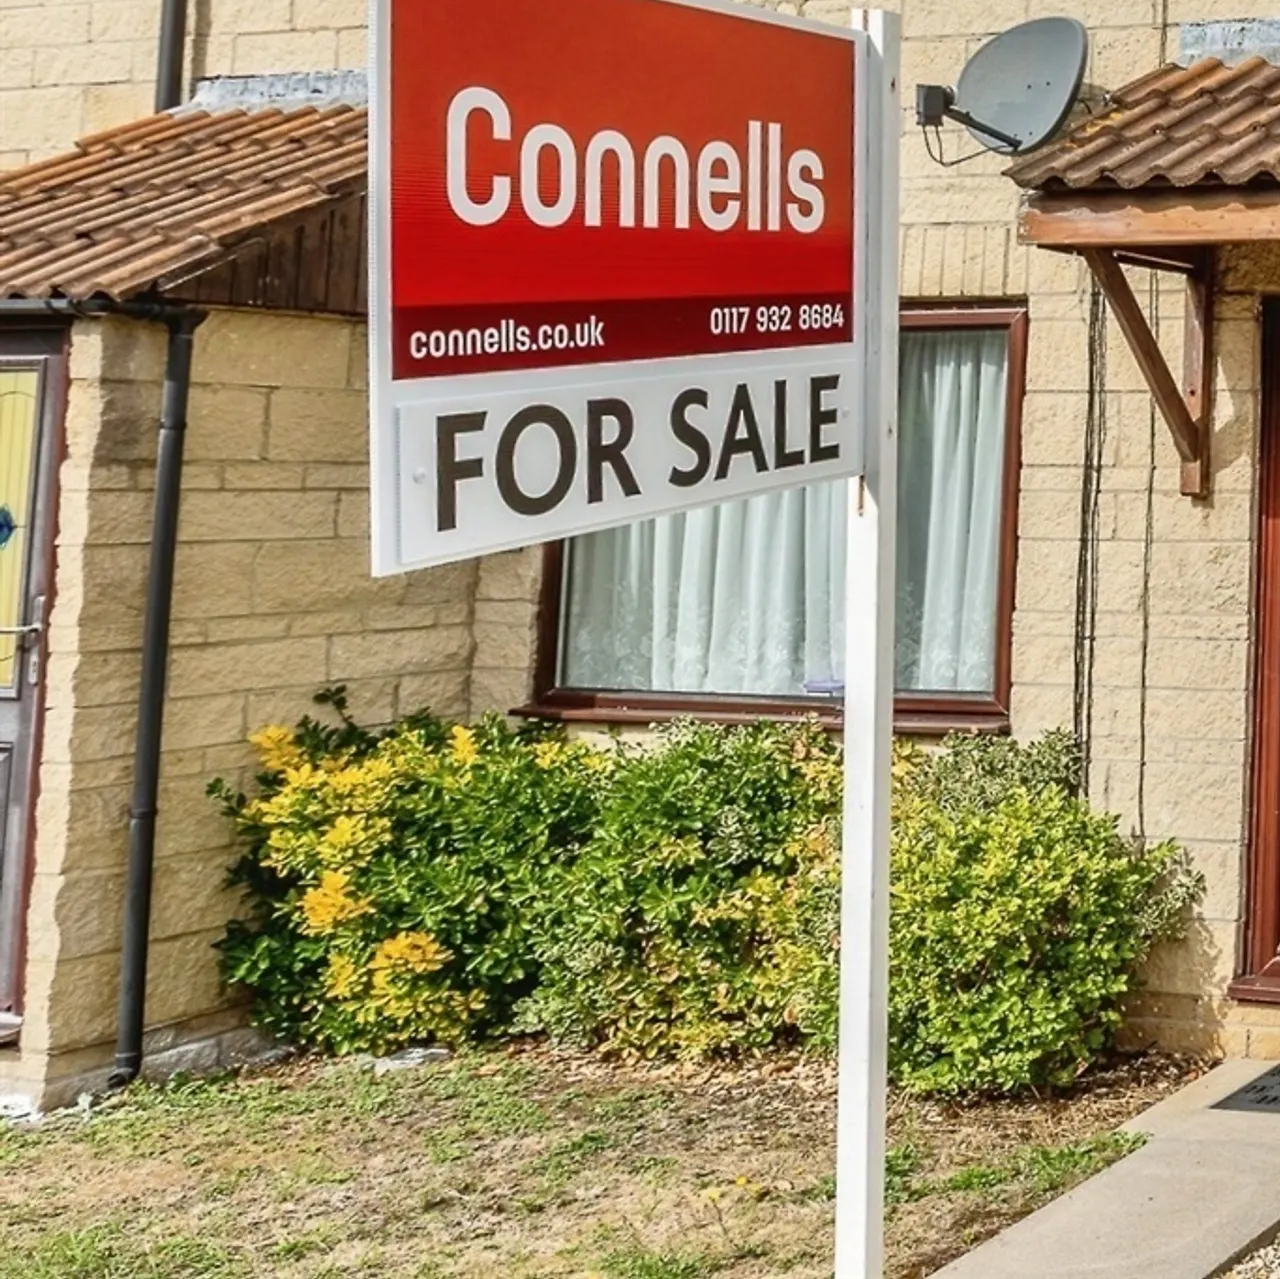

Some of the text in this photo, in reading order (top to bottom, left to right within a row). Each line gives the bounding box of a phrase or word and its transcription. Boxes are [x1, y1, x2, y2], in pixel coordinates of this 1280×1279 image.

[445, 86, 825, 233] Connells
[410, 315, 605, 359] connells.co.uk
[710, 303, 844, 335] 0117 932 8684
[435, 374, 841, 533] FOR SALE
